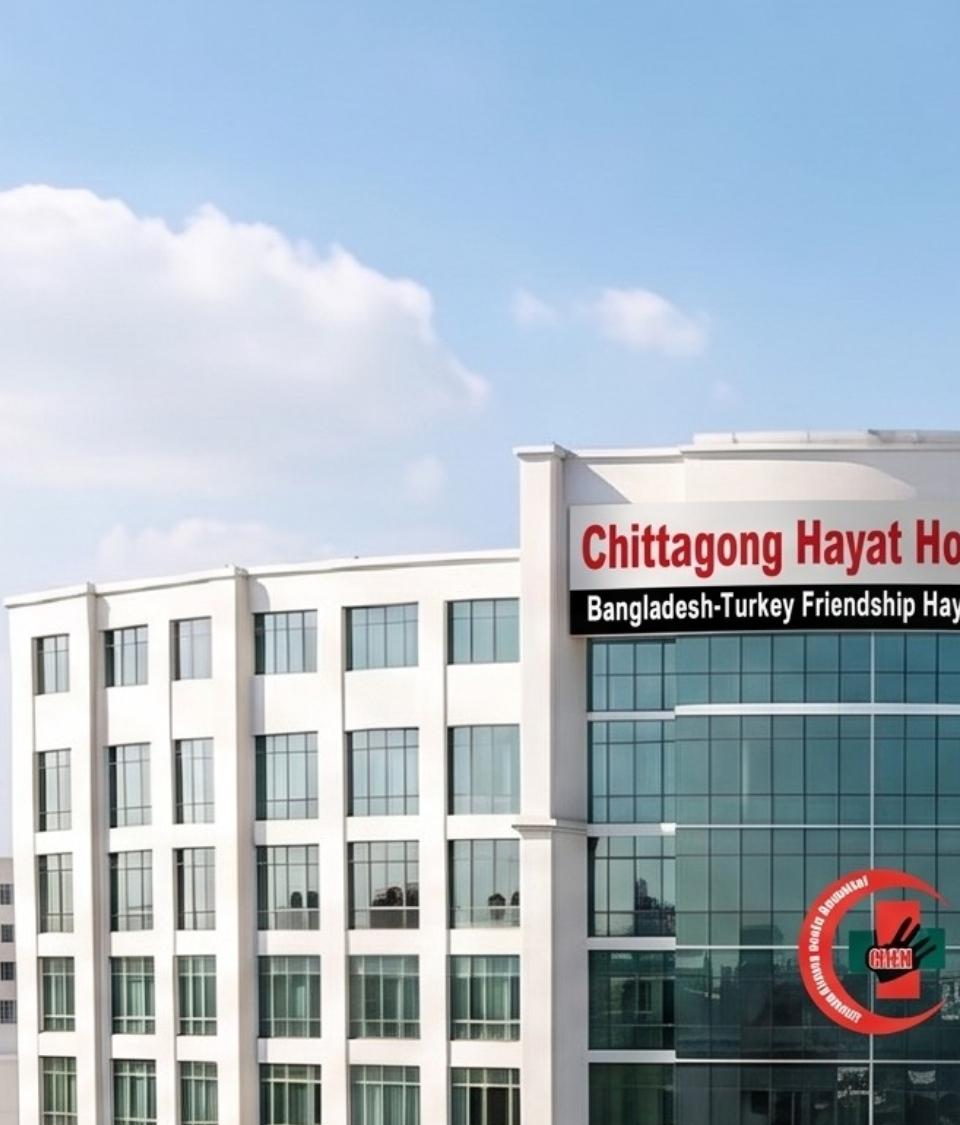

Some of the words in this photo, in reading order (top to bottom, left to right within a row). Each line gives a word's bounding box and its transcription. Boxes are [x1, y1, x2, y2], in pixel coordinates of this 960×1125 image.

[582, 524, 783, 580] Chittagong
[796, 520, 902, 576] Hayat
[587, 592, 794, 627] Bangladesh-Turkey
[803, 590, 915, 623] Friendship
